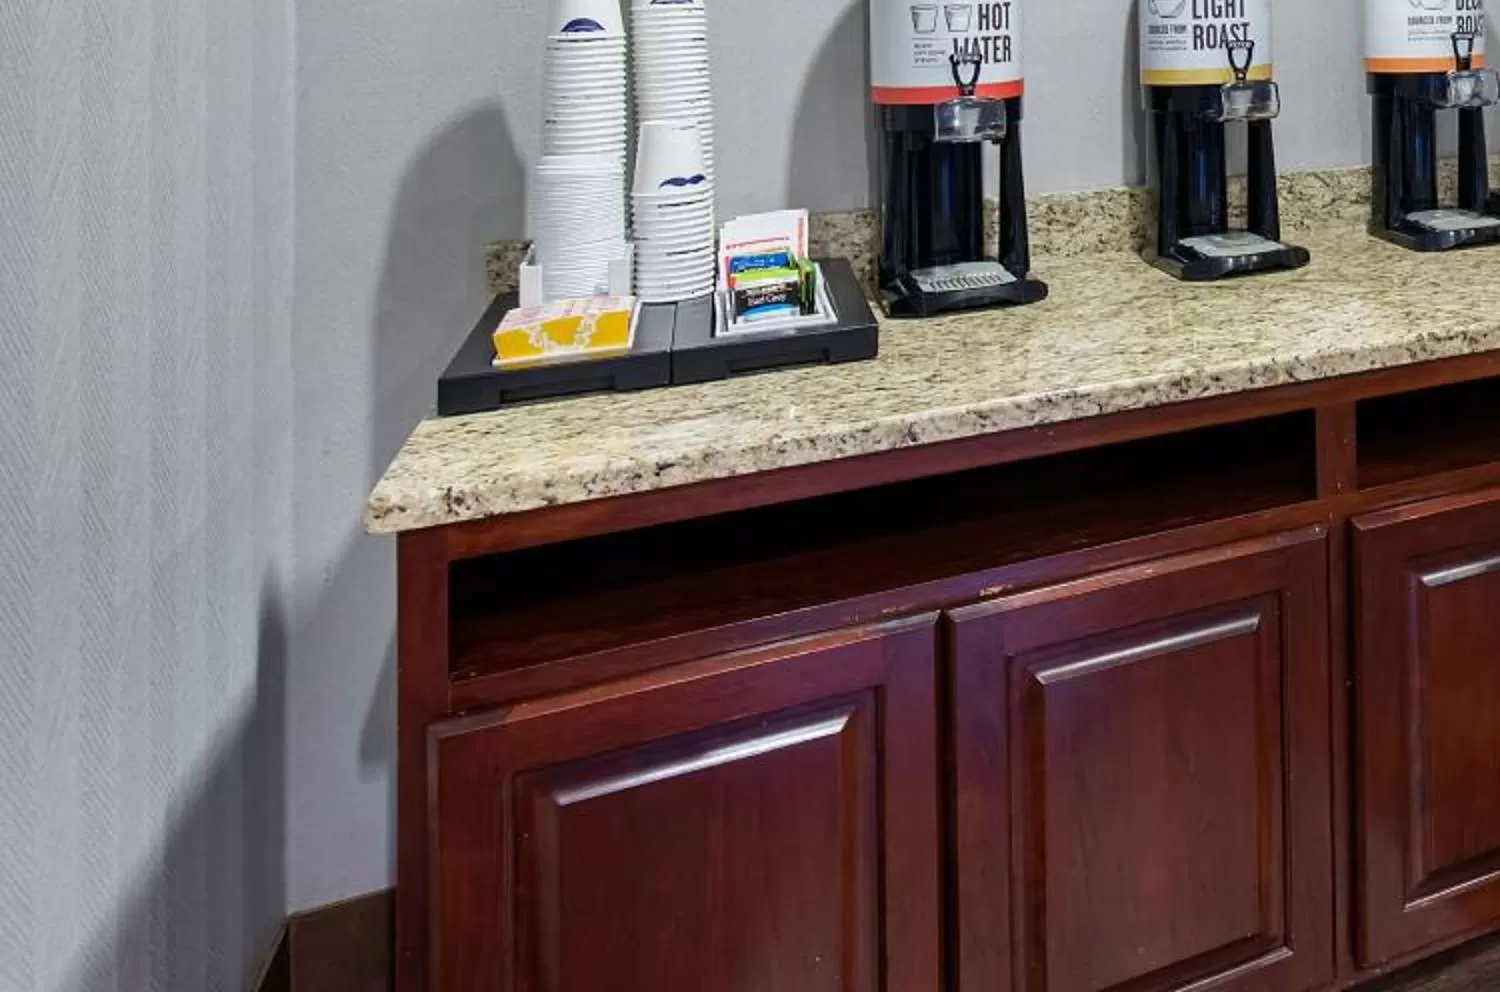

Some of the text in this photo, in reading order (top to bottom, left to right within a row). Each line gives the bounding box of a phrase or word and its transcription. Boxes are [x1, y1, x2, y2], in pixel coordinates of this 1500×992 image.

[977, 1, 1012, 31] HOT
[952, 35, 1012, 64] WATER
[1192, 22, 1251, 51] ROAST
